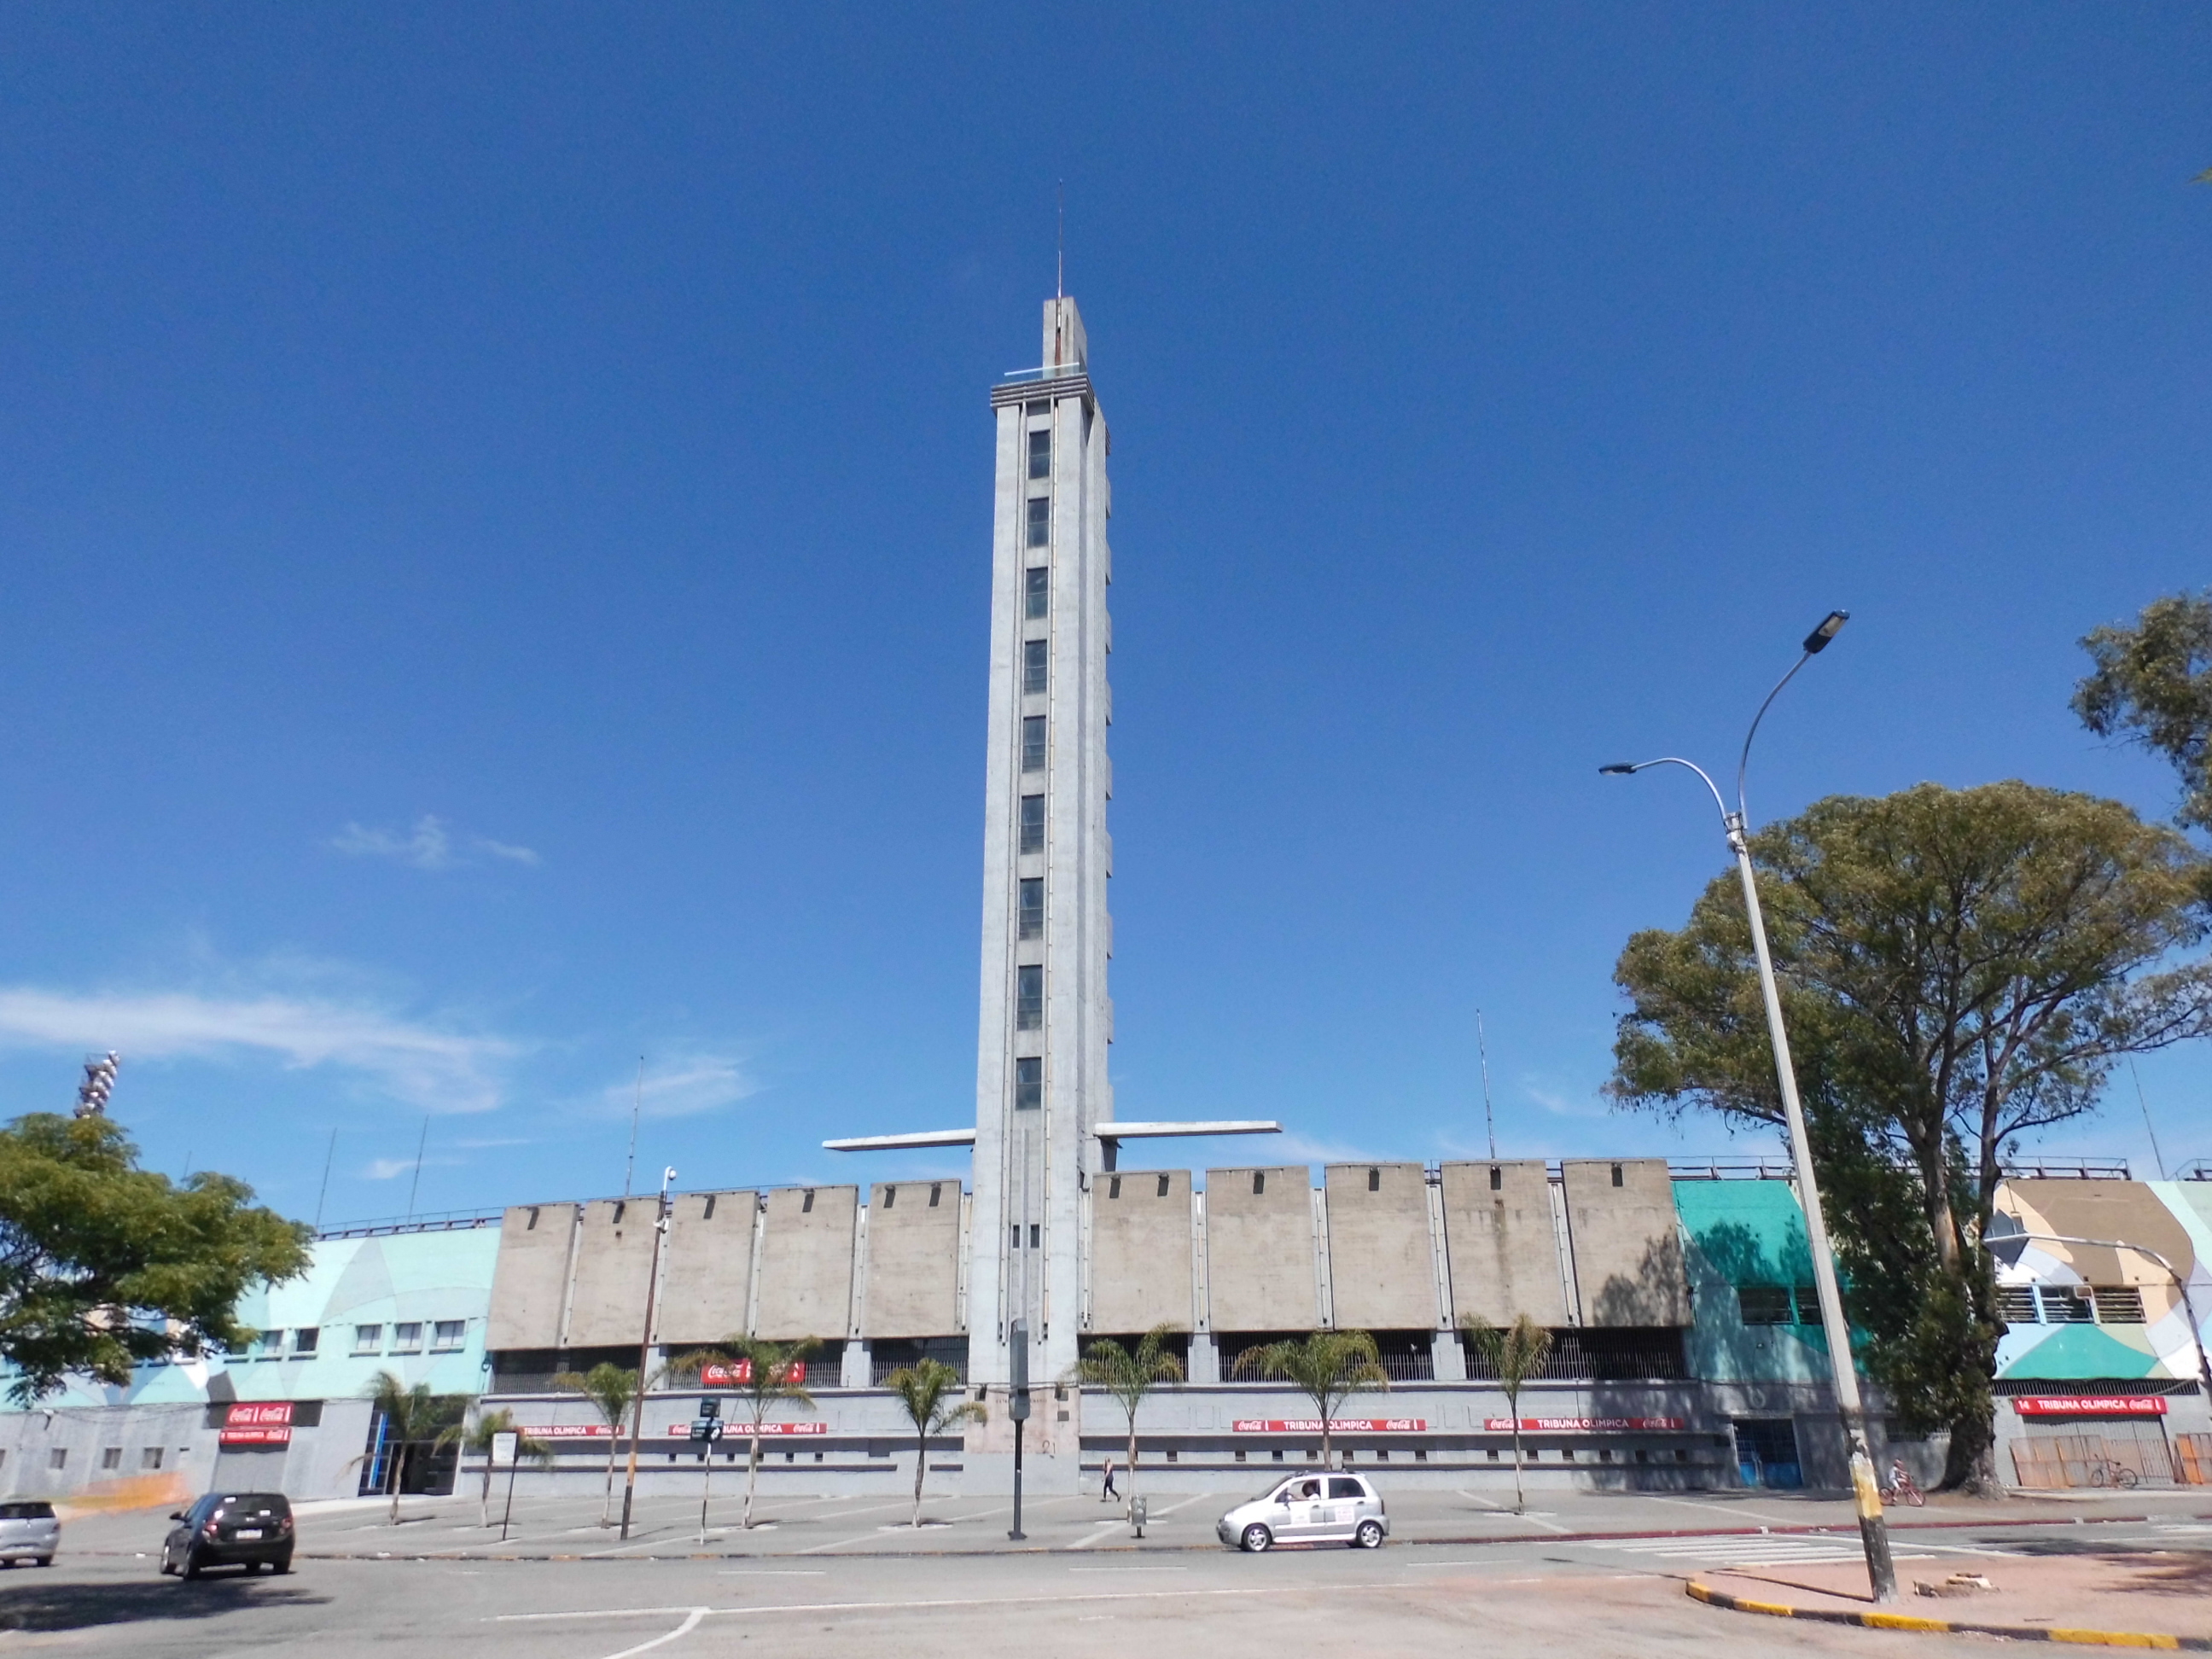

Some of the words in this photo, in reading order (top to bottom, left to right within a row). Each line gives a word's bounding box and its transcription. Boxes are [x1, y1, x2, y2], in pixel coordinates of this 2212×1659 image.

[2017, 1400, 2029, 1409] 14
[2037, 1400, 2079, 1410] TRIBUNA
[2081, 1400, 2126, 1410] OLIMPICA
[1284, 1421, 1324, 1430] TRIBUNA
[1329, 1420, 1373, 1430] OLIMPICA
[1537, 1419, 1581, 1429] TRIBUNA
[1582, 1418, 1629, 1429] OLIMPICA
[524, 1427, 552, 1435] TRIBUNA
[553, 1426, 587, 1435] OLIMPICA
[744, 1424, 783, 1434] OLMPICA
